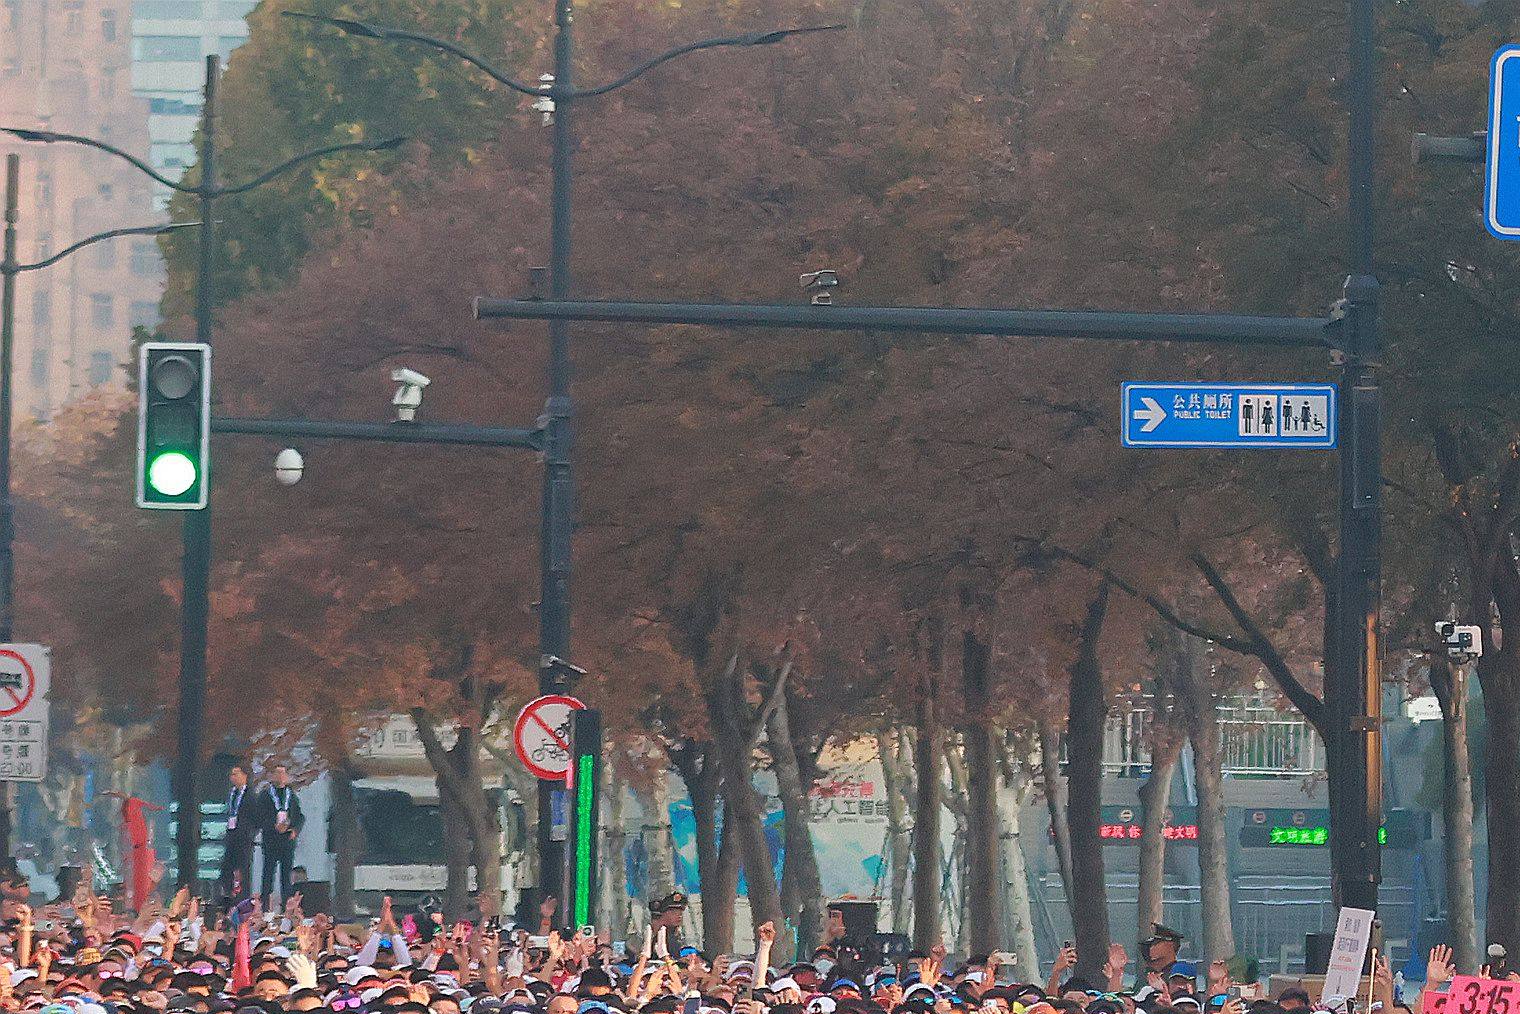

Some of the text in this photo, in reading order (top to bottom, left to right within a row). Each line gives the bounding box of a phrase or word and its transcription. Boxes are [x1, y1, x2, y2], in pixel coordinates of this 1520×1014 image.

[1173, 392, 1234, 410] 公共厕所
[1174, 410, 1232, 420] PUBLIC TOILET
